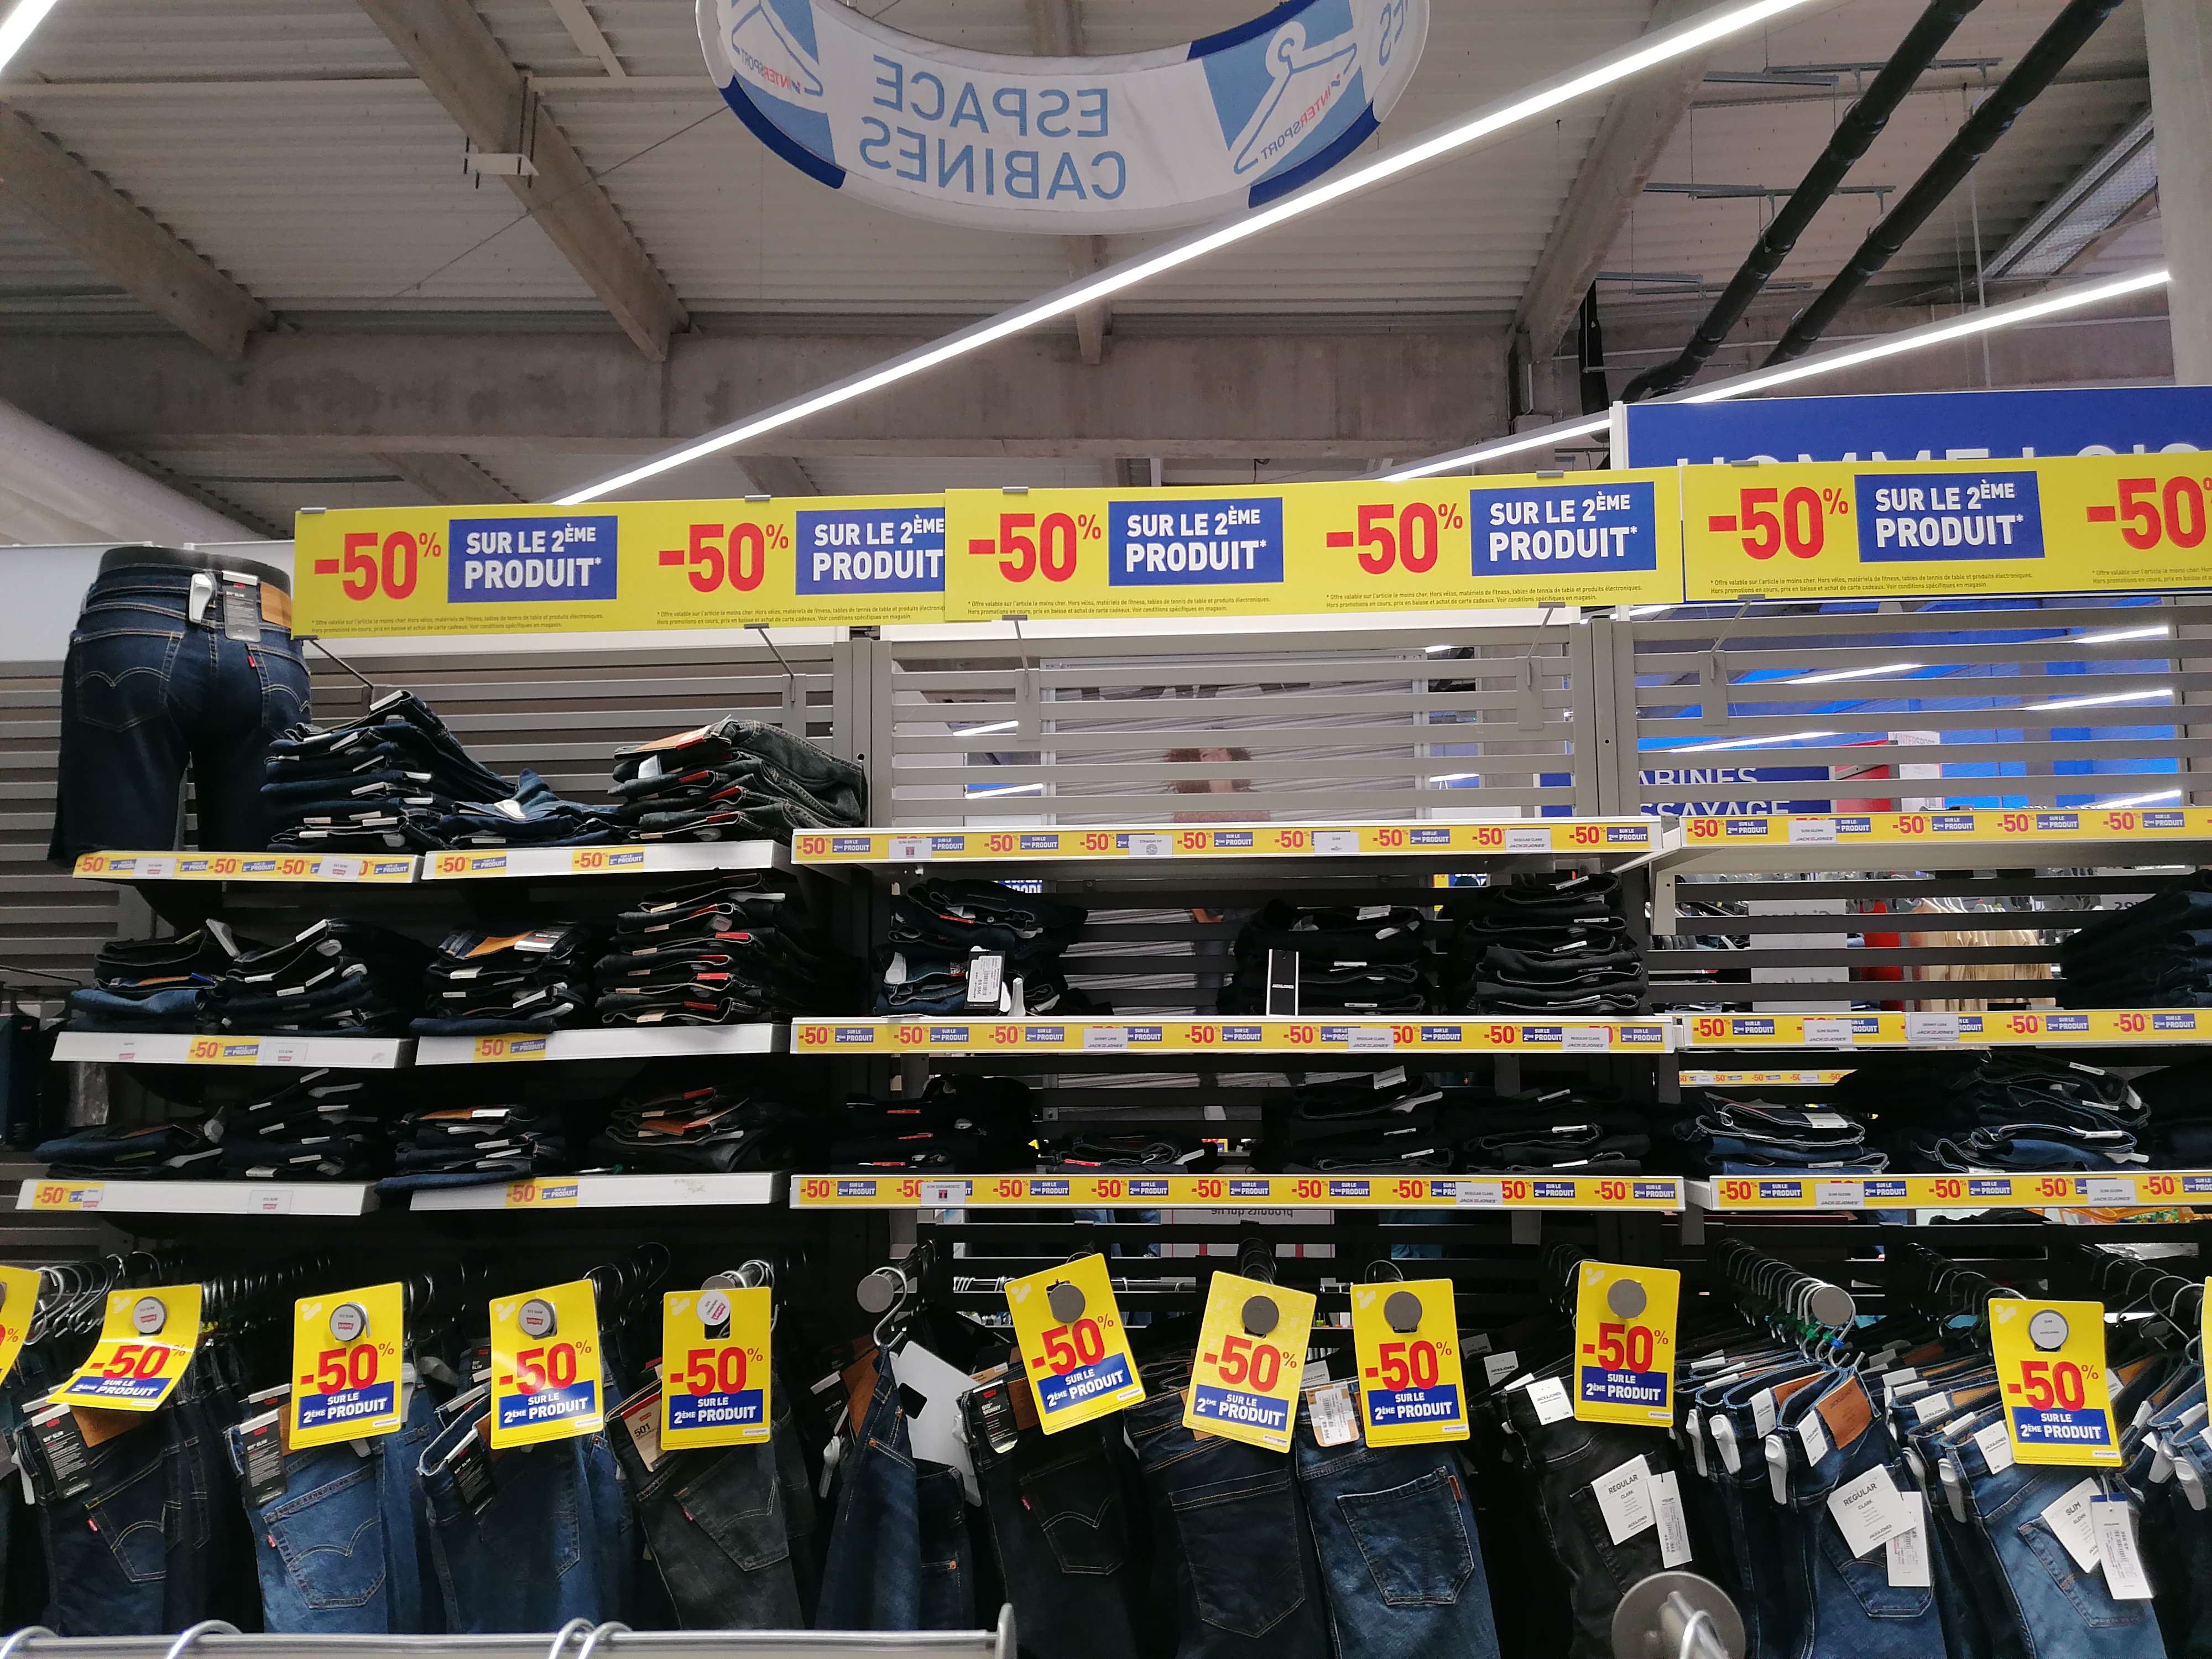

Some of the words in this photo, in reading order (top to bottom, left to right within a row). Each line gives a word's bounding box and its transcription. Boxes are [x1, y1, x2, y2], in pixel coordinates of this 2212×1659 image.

[1875, 488, 1926, 513] SUR
[1930, 487, 1961, 511] LE
[1490, 501, 1539, 526] SUR
[1546, 499, 1575, 524] LE
[1708, 486, 1849, 561] -50%
[814, 523, 860, 546] SUR
[867, 522, 894, 545] LE
[1126, 514, 1173, 538] SUR
[1180, 513, 1209, 536] LE
[466, 531, 513, 555] SUR
[518, 530, 546, 554] LE
[968, 512, 1102, 583] -50%
[1326, 502, 1463, 575] -50%
[315, 531, 441, 601] -50%
[658, 523, 789, 593] -50%
[1031, 1314, 1114, 1375] -50%
[1582, 1322, 1669, 1374] -50%
[88, 1343, 186, 1380] -50%
[300, 1343, 395, 1395] -50%
[499, 1341, 592, 1395] -50%
[669, 1346, 764, 1396] -50%
[1203, 1335, 1297, 1393] -50%
[1364, 1340, 1453, 1392] -50%
[102, 1379, 124, 1388] SUR
[1065, 1373, 1083, 1387] SUR
[1082, 1368, 1096, 1381] LE
[1068, 1369, 1125, 1401] PRODUIT
[1607, 1374, 1624, 1383] SUR
[1625, 1375, 1636, 1384] LE
[2007, 1360, 2099, 1411] -50%
[96, 1384, 159, 1397] PRODUIT
[327, 1394, 347, 1405] SUR
[347, 1392, 361, 1404] LE
[528, 1393, 548, 1407] SUR
[547, 1391, 561, 1404] LE
[697, 1398, 716, 1407] SUR
[717, 1397, 729, 1406] LE
[1225, 1394, 1245, 1406] SUR
[1245, 1397, 1258, 1408] LE
[1395, 1393, 1413, 1403] SUR
[1413, 1392, 1425, 1402] LE
[1608, 1385, 1661, 1401] PRODUIT
[327, 1397, 388, 1421] PRODUIT
[528, 1396, 589, 1421] PRODUIT
[697, 1405, 757, 1422] PRODUIT
[1396, 1400, 1453, 1418] PRODUIT
[2041, 1413, 2060, 1422] SUR
[2059, 1413, 2073, 1423] LE
[2043, 1425, 2102, 1439] PRODUIT
[1608, 1474, 1639, 1494] REGULAR
[1621, 1490, 1634, 1499] CLARK
[1843, 1483, 1877, 1506] REGULAR
[1858, 1499, 1873, 1510] CLARK
[2065, 1501, 2081, 1516] SLIM
